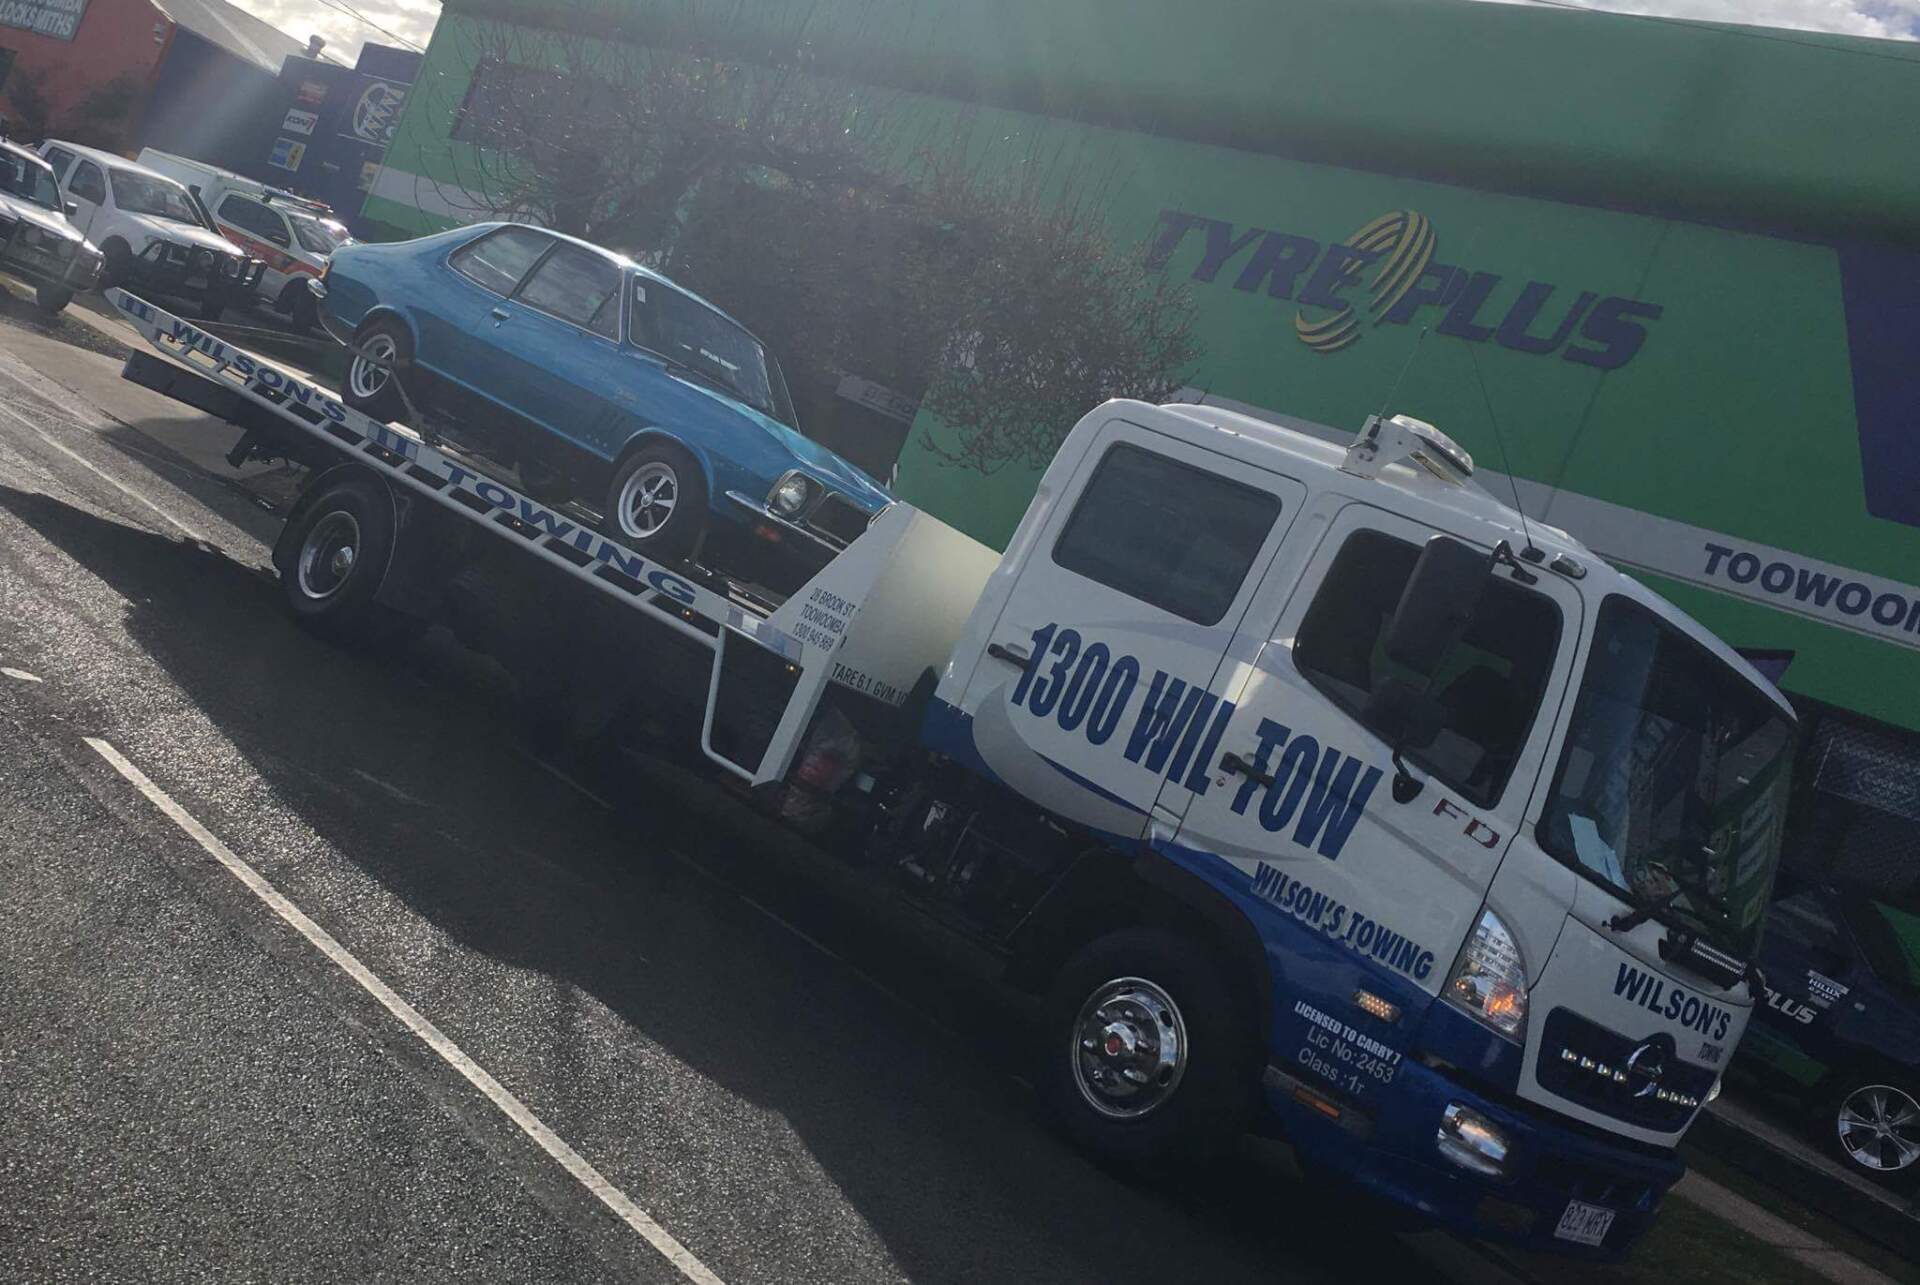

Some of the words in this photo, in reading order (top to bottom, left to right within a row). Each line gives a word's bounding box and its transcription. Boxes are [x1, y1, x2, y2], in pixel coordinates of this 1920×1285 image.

[173, 320, 346, 423] WILSON'S
[443, 460, 696, 605] TOWING
[800, 603, 847, 636] TOOWOOMBA
[832, 662, 859, 686] TARE
[873, 680, 897, 702] GVM
[1010, 622, 1140, 746] 1300
[1432, 798, 1501, 850] FD
[1252, 860, 1346, 934] WILSON'S
[1344, 911, 1434, 979] TOWING
[1613, 962, 1731, 1042] WILSON'S
[1294, 1000, 1342, 1035] LICENSED
[1341, 1025, 1357, 1043] TO
[1356, 1033, 1394, 1061] CARRY
[1307, 1024, 1329, 1049] Lic
[1298, 1047, 1338, 1081] Class
